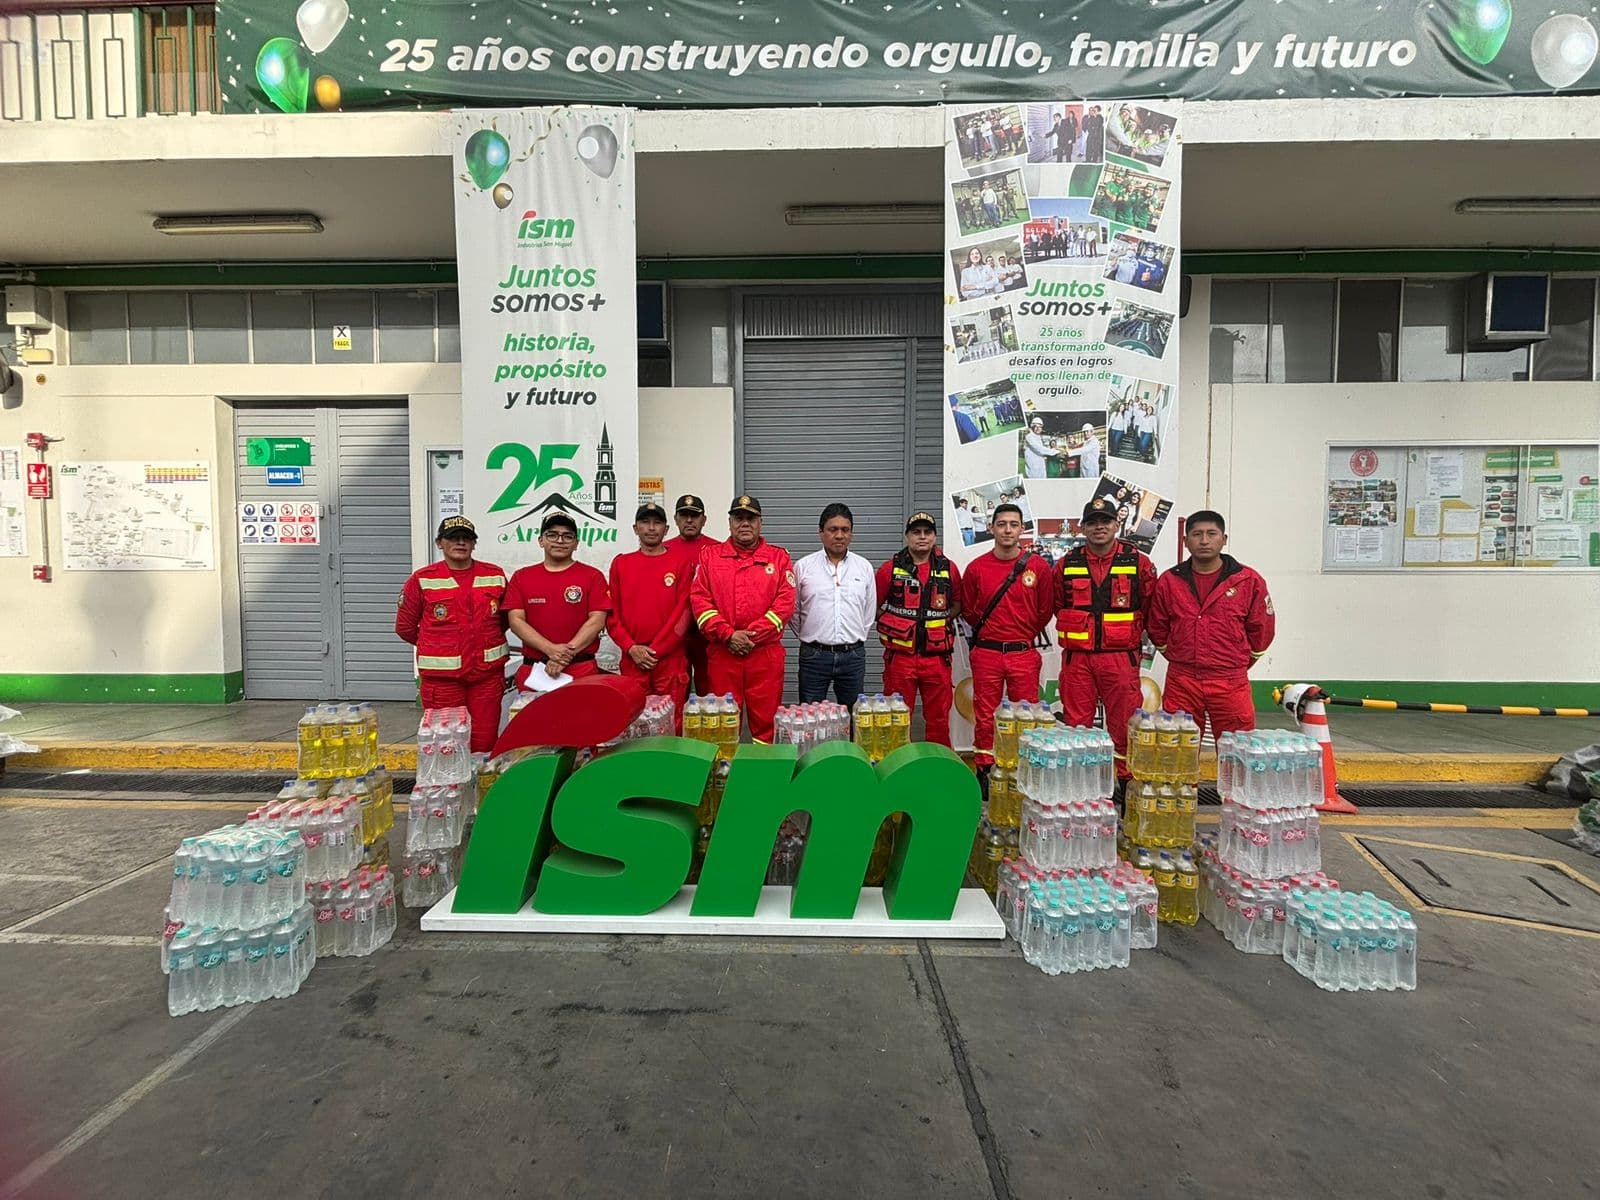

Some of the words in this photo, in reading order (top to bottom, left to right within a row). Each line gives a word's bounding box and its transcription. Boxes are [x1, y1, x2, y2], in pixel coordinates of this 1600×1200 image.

[380, 38, 438, 73] 25
[446, 36, 553, 72] años
[566, 37, 868, 77] construyendo
[883, 34, 1052, 74] orgullo,
[1068, 33, 1220, 69] familia
[1229, 43, 1264, 76] y
[1273, 34, 1416, 70] futuro
[517, 210, 576, 240] ism
[498, 264, 596, 289] Juntos
[1025, 278, 1105, 298] Juntos
[490, 293, 606, 313] somos+
[1018, 300, 1113, 317] somos+
[1040, 327, 1054, 338] 25
[1056, 326, 1083, 338] años
[503, 333, 595, 354] historia,
[1021, 342, 1106, 352] transformando
[494, 359, 607, 382] propósito
[1060, 358, 1073, 367] en
[1076, 355, 1113, 369] logros
[1010, 373, 1031, 384] que
[1035, 371, 1055, 381] nos
[1058, 370, 1093, 381] llenan
[1098, 369, 1111, 381] de
[504, 391, 520, 410] y
[526, 388, 597, 406] futuro
[1038, 385, 1082, 398] orgullo.
[486, 442, 585, 514] 25
[568, 491, 593, 501] Años
[599, 503, 614, 512] ism
[451, 673, 982, 921] ism
